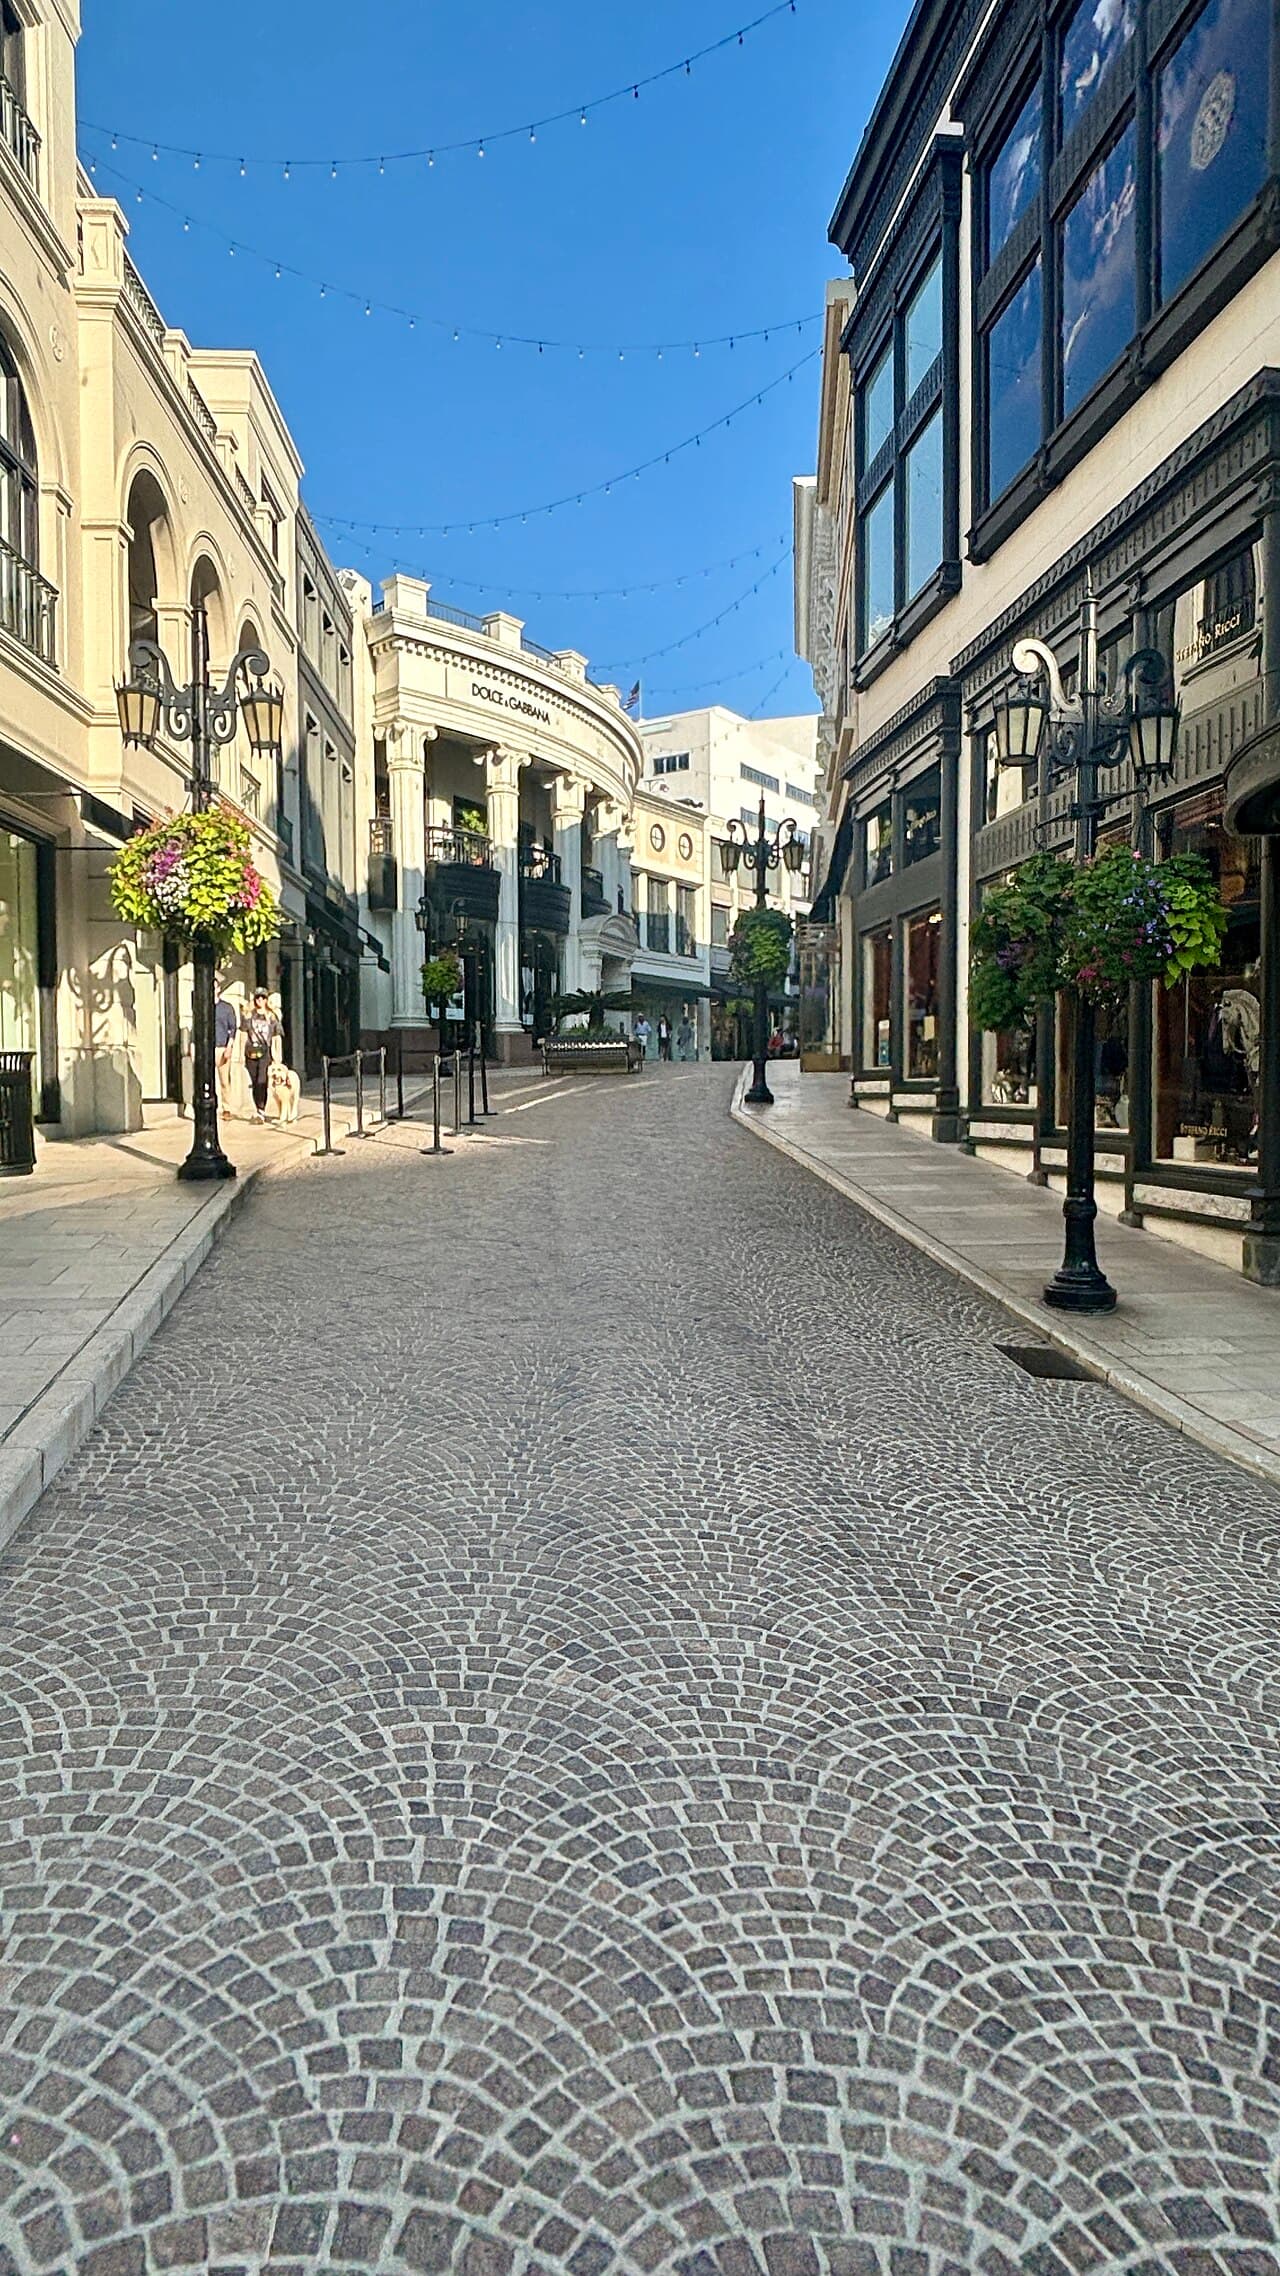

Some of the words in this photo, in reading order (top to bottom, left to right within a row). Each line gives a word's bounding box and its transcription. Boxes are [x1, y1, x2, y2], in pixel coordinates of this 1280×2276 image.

[1214, 613, 1241, 639] RICCI
[472, 683, 503, 706] DOLCE
[509, 697, 551, 726] GABBANA
[1208, 1124, 1228, 1137] RICCI
